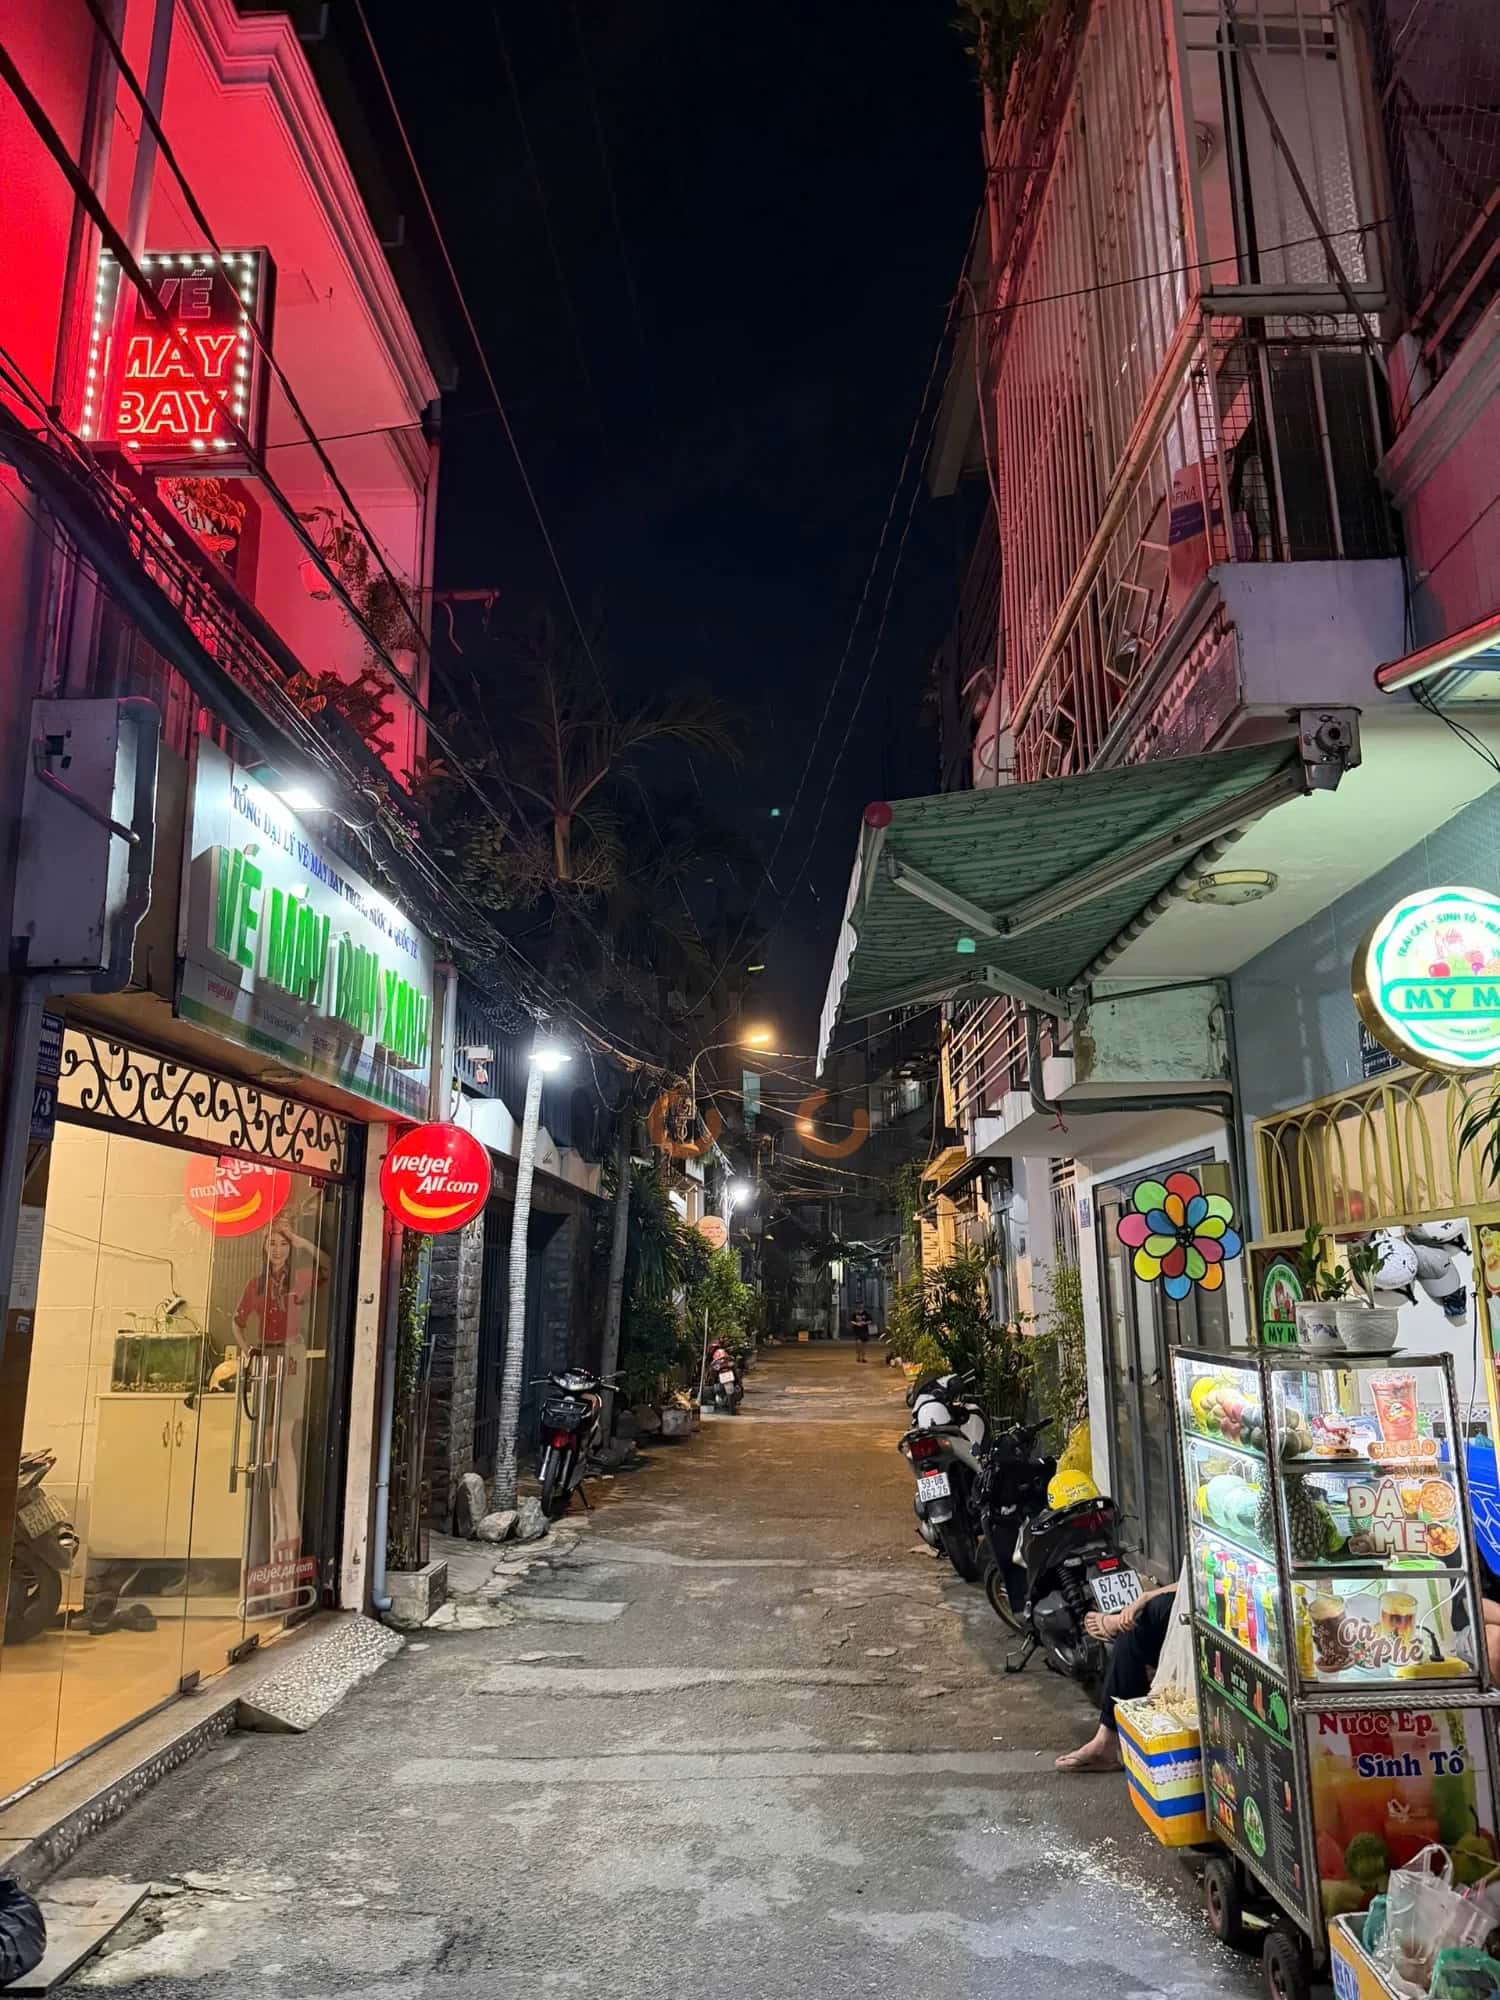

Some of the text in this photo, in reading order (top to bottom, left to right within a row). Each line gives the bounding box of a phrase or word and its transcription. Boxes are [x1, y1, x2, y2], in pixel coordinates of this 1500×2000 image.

[116, 390, 229, 433] BAY
[1405, 987, 1457, 1010] MY
[1267, 1326, 1284, 1343] MY
[1373, 1520, 1428, 1553] ME
[1337, 1616, 1376, 1648] Cà
[1370, 1635, 1424, 1668] Phê
[1358, 1745, 1465, 1778] Sinh Tố
